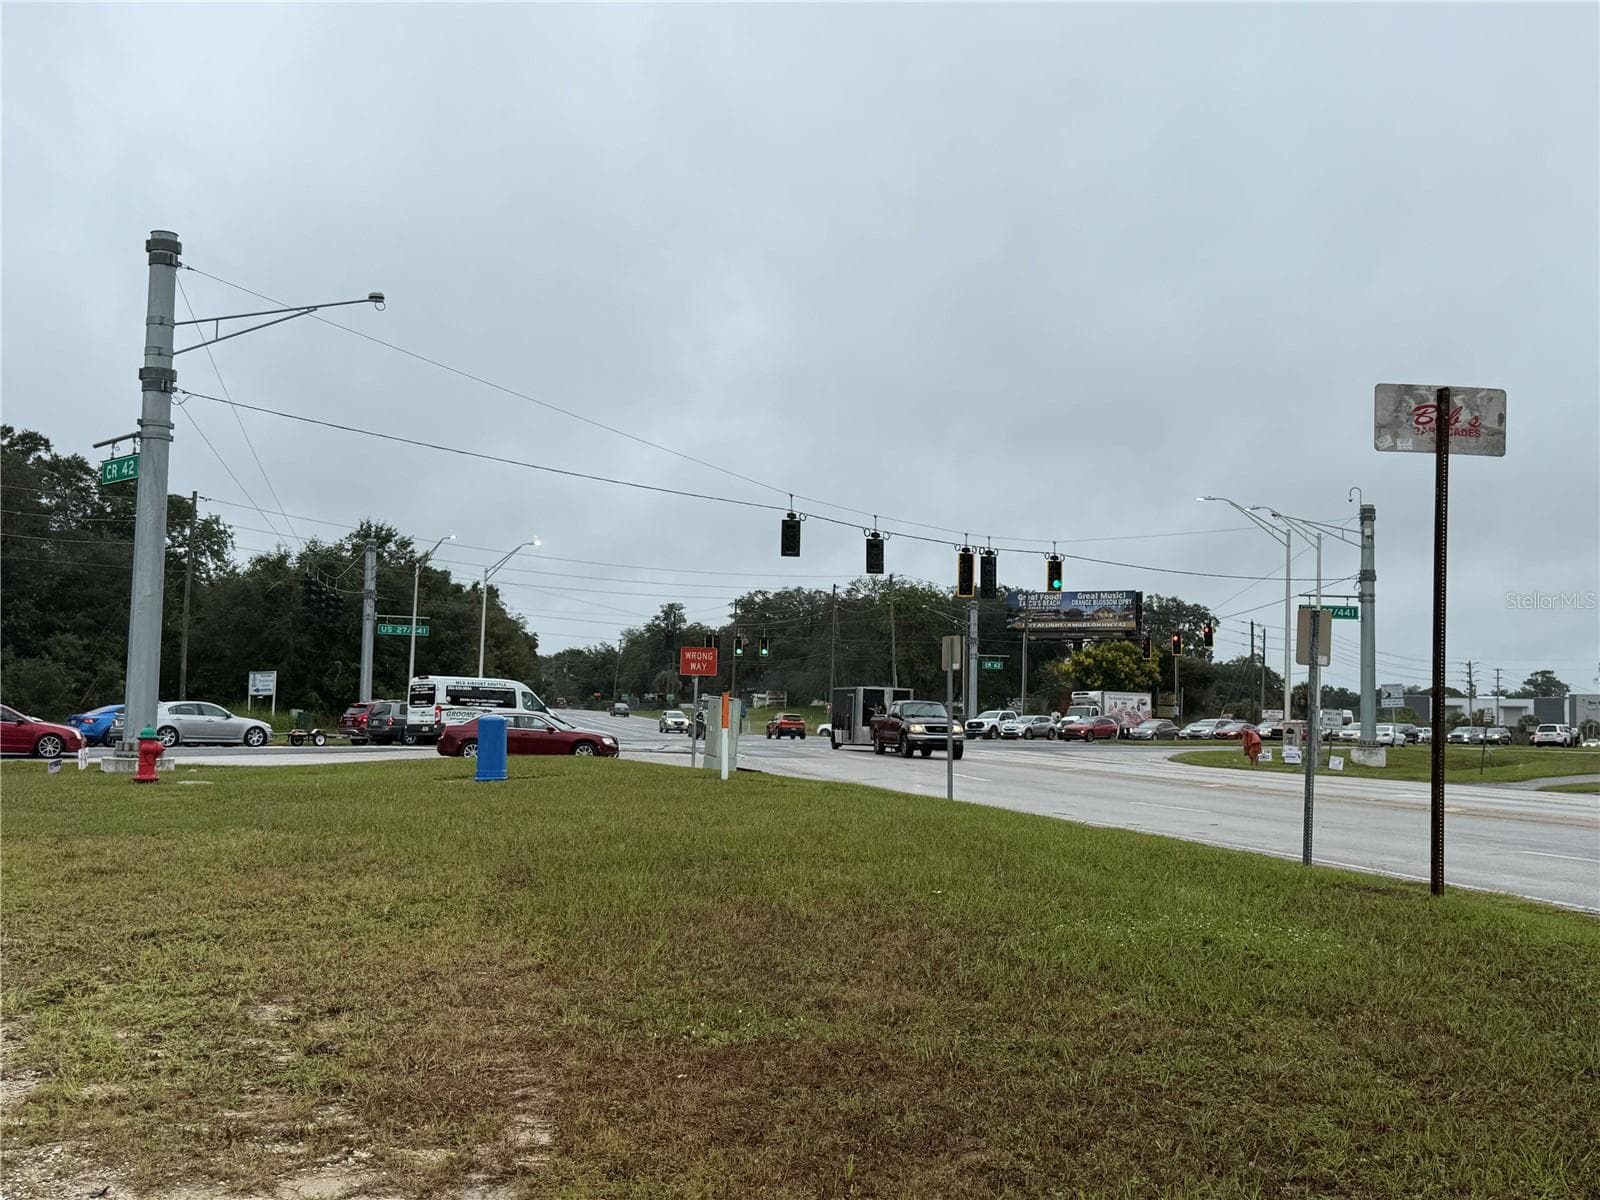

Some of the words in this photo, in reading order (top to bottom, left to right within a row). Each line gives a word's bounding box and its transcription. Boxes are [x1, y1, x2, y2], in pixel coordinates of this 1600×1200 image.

[106, 464, 118, 480] CR
[122, 460, 135, 475] 42
[1077, 592, 1098, 600] Great
[1100, 592, 1126, 600] Music!
[381, 625, 393, 633] US
[396, 626, 426, 634] 27/41
[685, 651, 713, 661] WRONG
[690, 662, 708, 671] WAY
